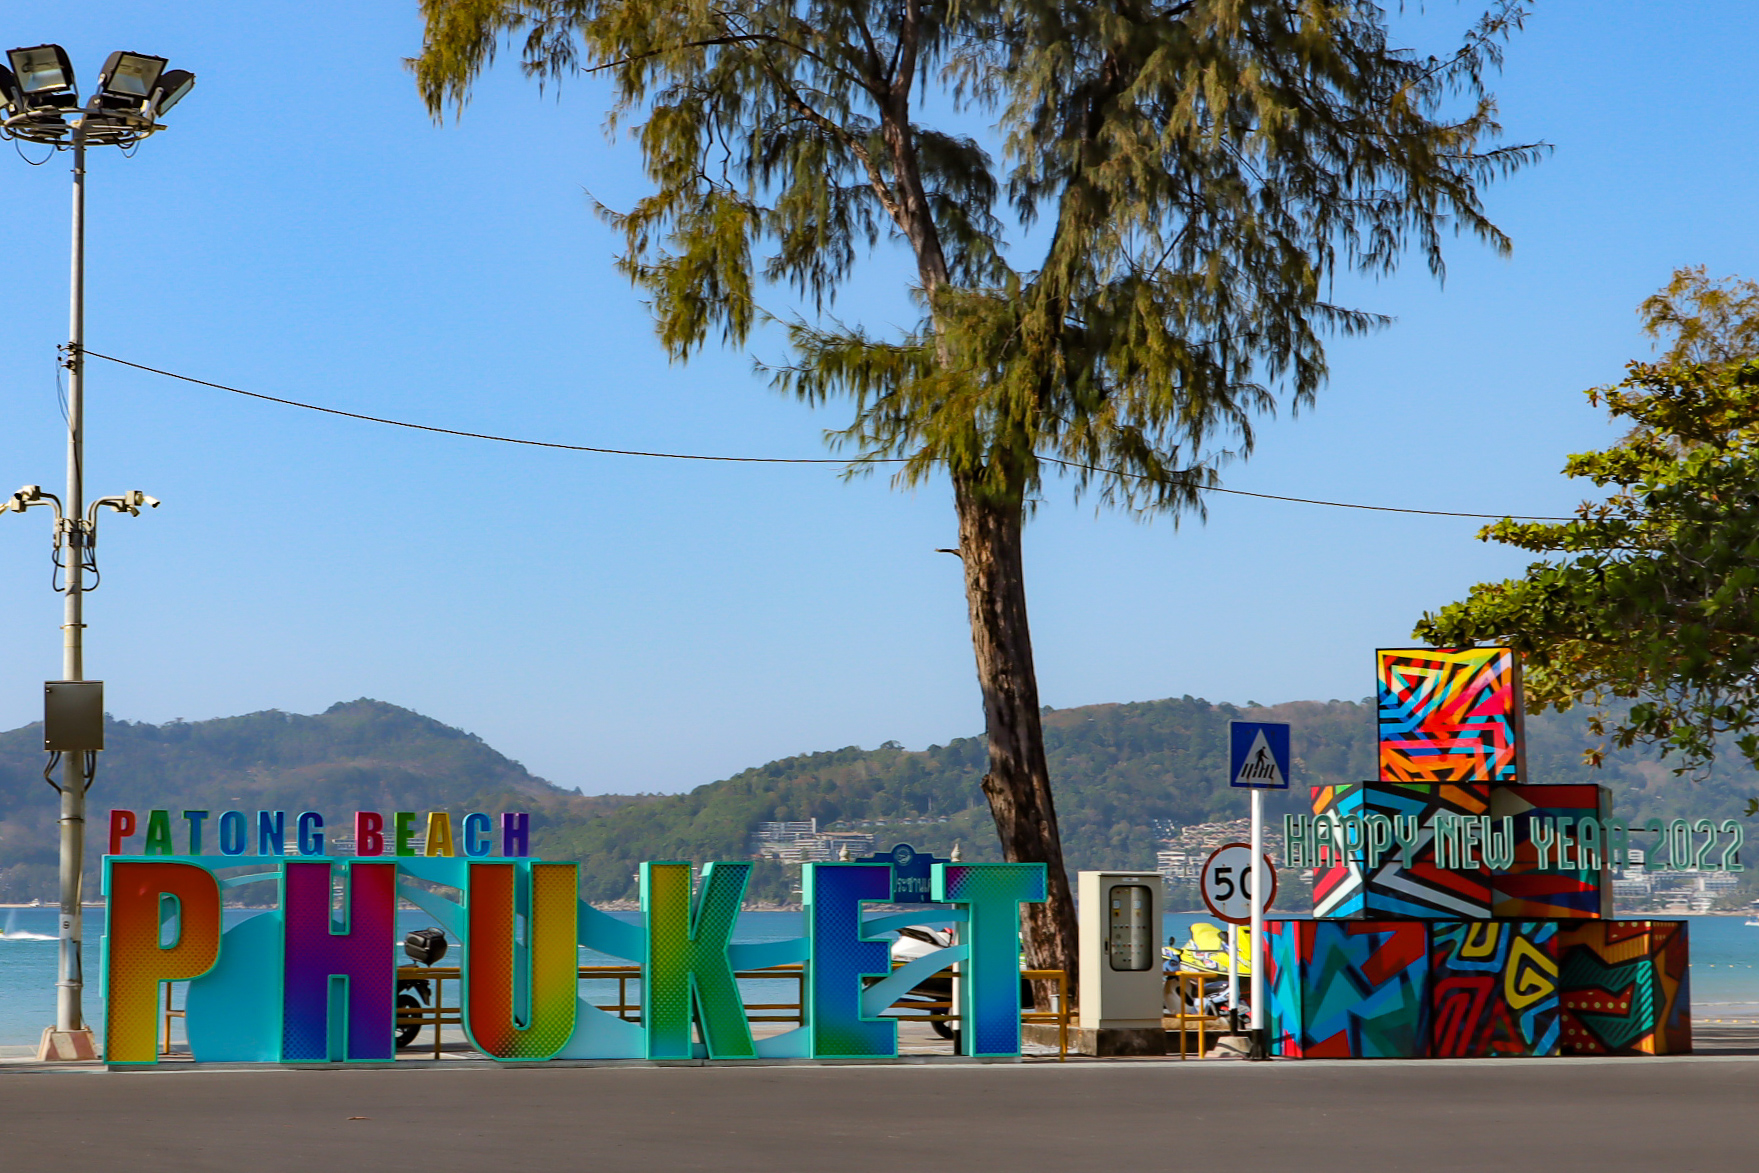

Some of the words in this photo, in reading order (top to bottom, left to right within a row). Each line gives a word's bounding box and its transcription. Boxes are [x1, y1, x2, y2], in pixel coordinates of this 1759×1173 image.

[108, 809, 325, 856] PATONG
[354, 810, 530, 857] BEACH
[1283, 813, 1419, 870] HAPPY
[1434, 815, 1514, 870] NEW
[1530, 815, 1629, 871] YEAR
[1644, 817, 1744, 873] 2022
[102, 856, 1048, 1063] PHUKET
